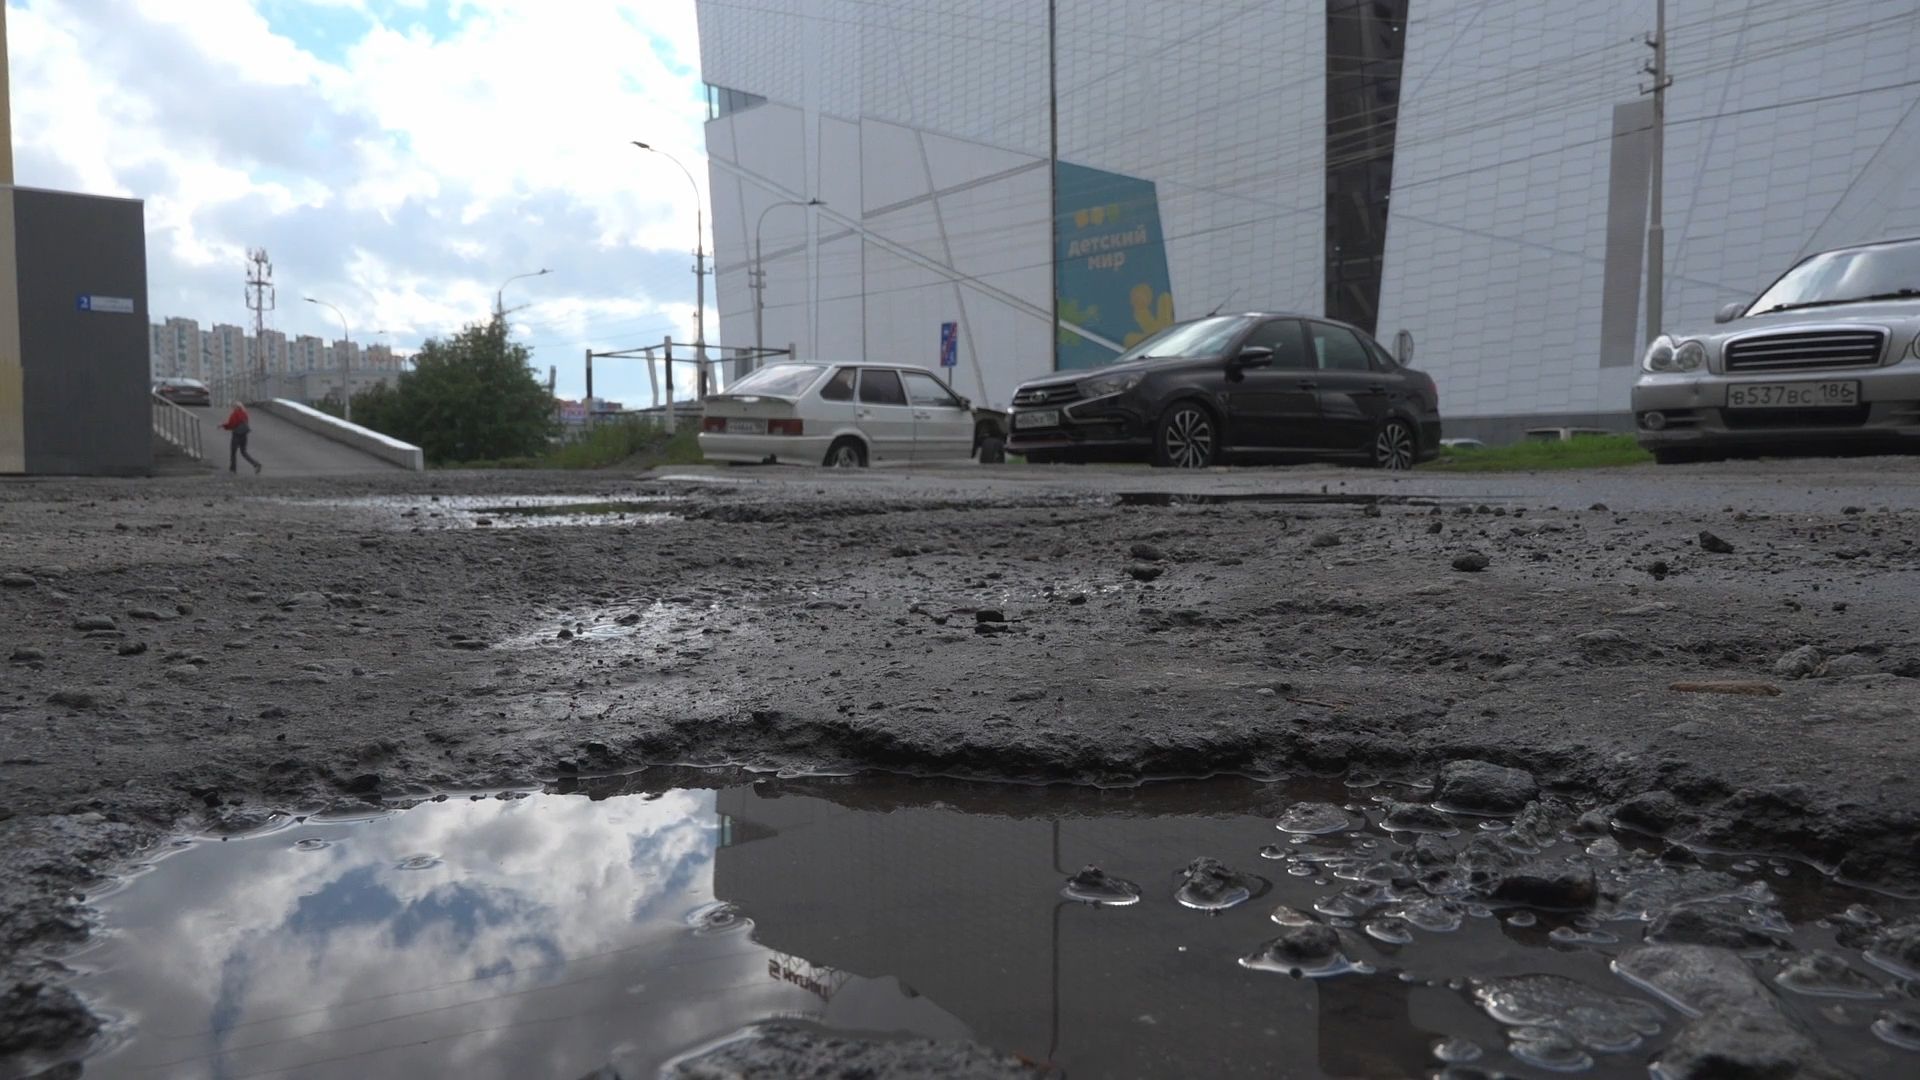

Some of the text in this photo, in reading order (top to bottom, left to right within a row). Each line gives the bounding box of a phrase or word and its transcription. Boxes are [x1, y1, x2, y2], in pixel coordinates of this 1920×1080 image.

[1087, 251, 1126, 271] мир
[80, 295, 89, 309] 2
[1820, 383, 1849, 398] 186
